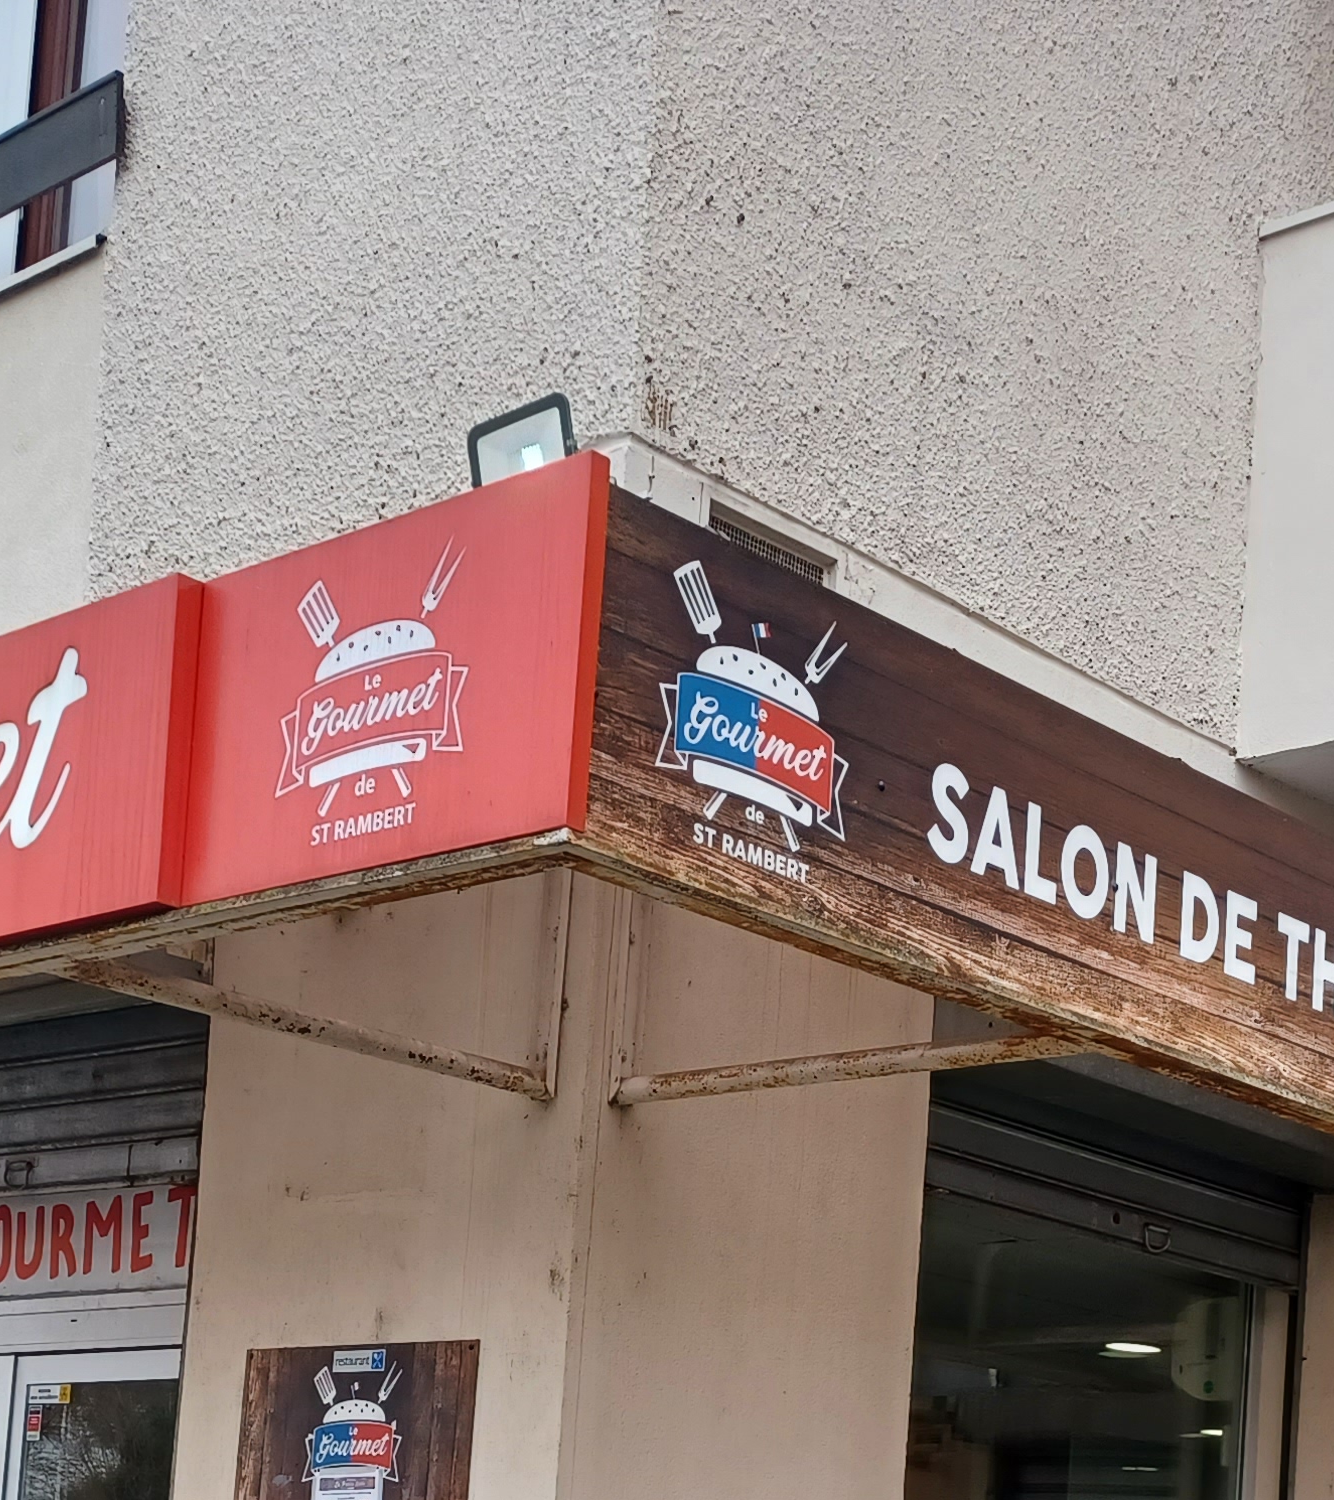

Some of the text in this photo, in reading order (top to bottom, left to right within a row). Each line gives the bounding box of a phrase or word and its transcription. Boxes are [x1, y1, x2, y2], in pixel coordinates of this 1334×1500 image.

[364, 674, 381, 691] Le
[301, 668, 444, 756] Gourmet
[751, 702, 768, 723] Le
[684, 691, 827, 782] Gourmet
[354, 774, 375, 797] de
[310, 802, 416, 846] ST RAMBERT
[745, 803, 765, 825] de
[693, 823, 809, 884] ST RAMBERT
[927, 763, 1157, 944] SALON
[1179, 870, 1258, 985] DE
[335, 1356, 370, 1367] restaurant
[315, 1433, 389, 1463] Gourmet
